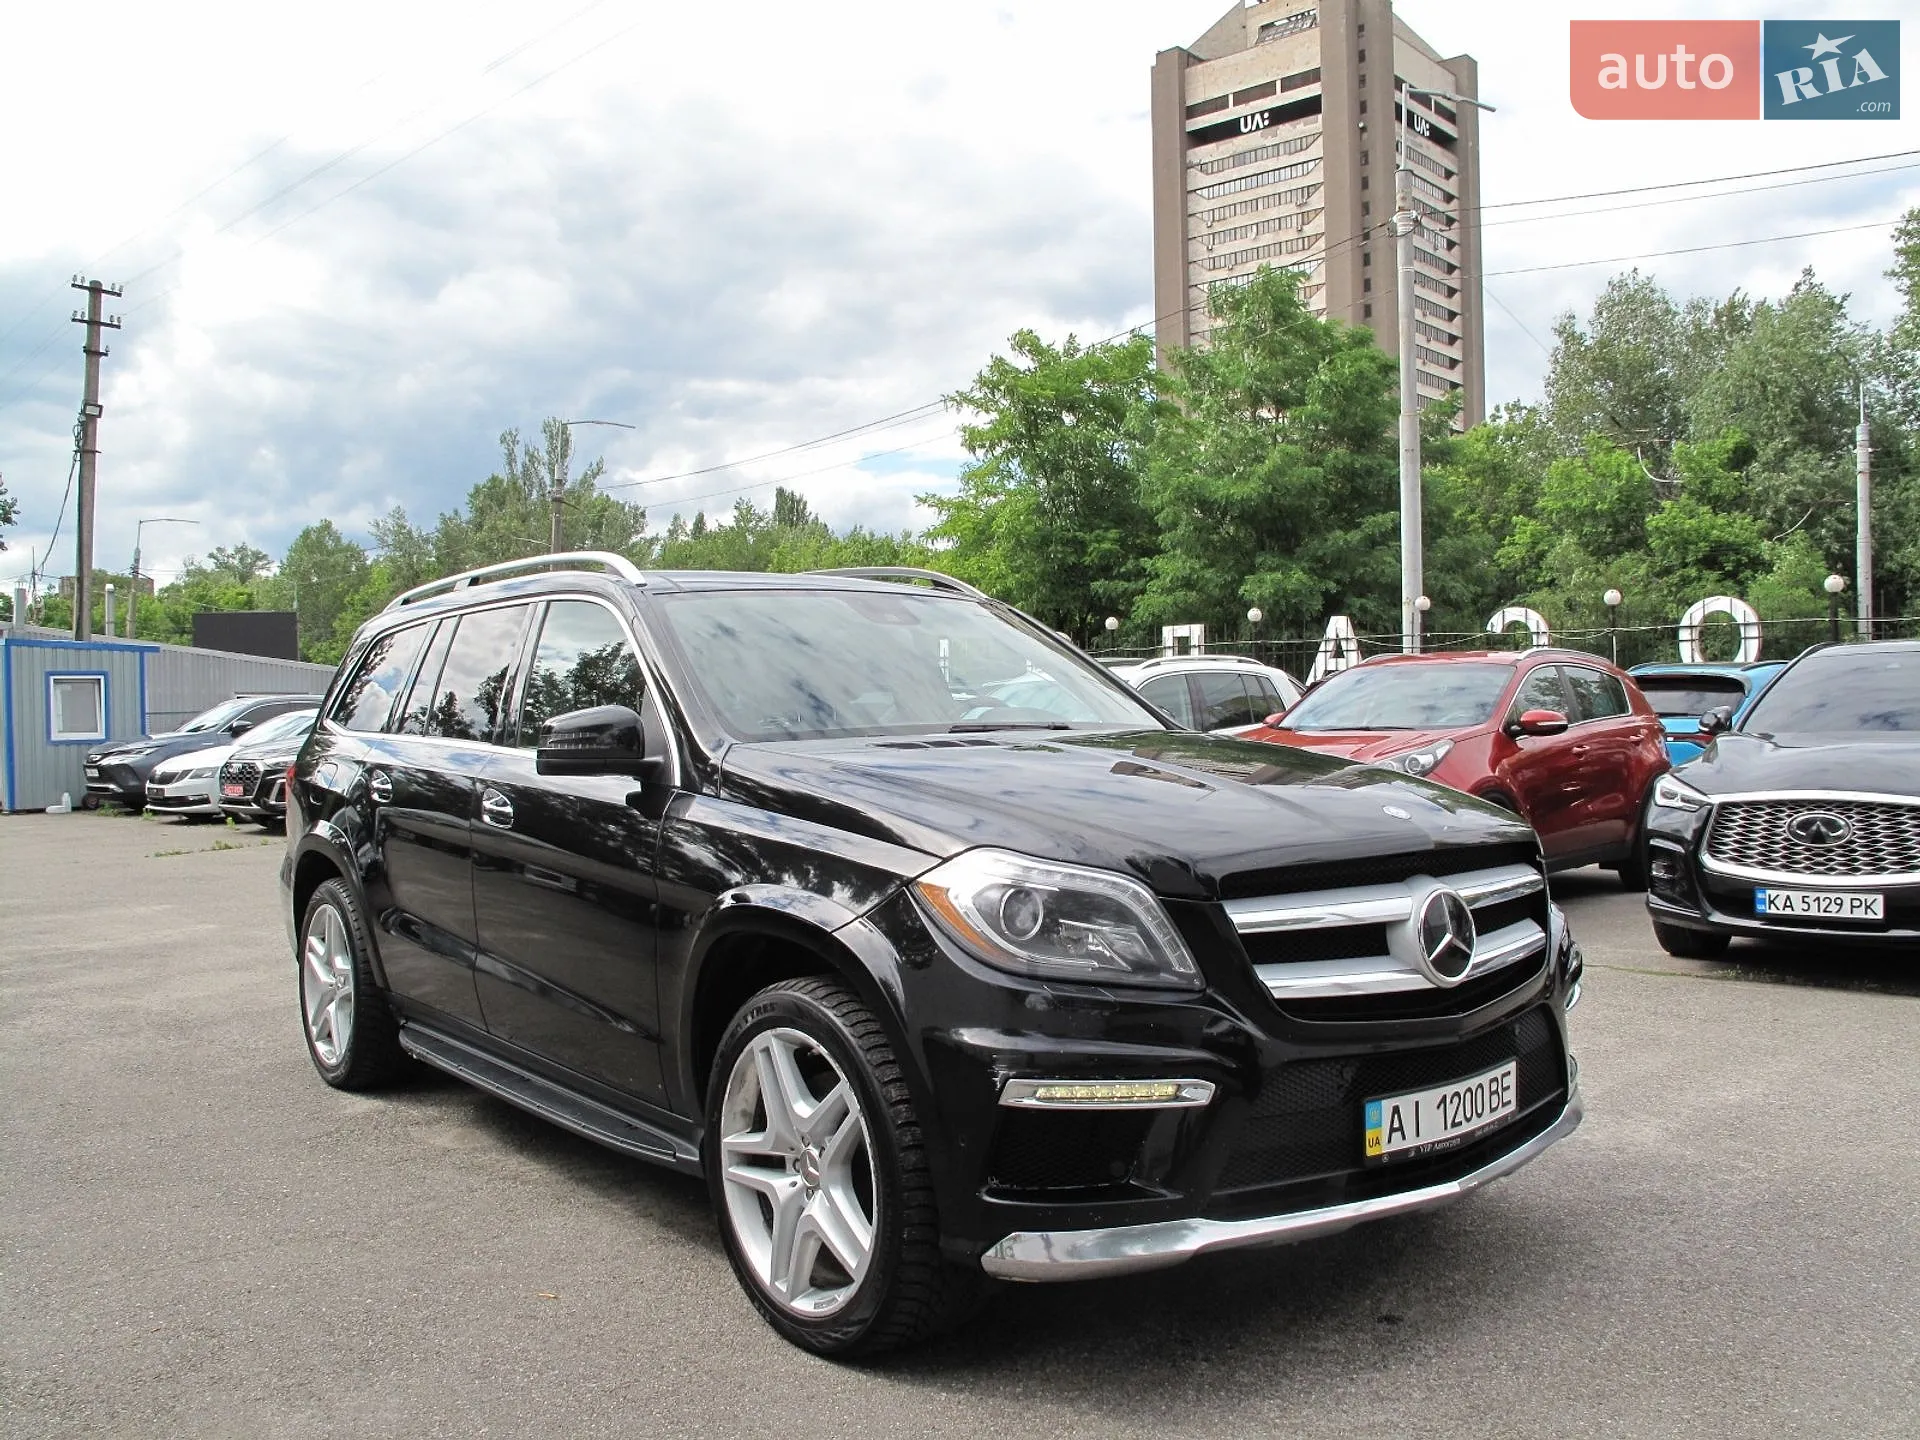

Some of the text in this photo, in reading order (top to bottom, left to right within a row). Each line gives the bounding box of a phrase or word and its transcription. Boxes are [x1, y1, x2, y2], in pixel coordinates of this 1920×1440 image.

[1768, 893, 1878, 916] KA 5129 PK
[1387, 1100, 1420, 1144] AI
[1436, 1082, 1485, 1131] 1200
[1488, 1070, 1512, 1114] BE
[1368, 1137, 1381, 1149] UA
